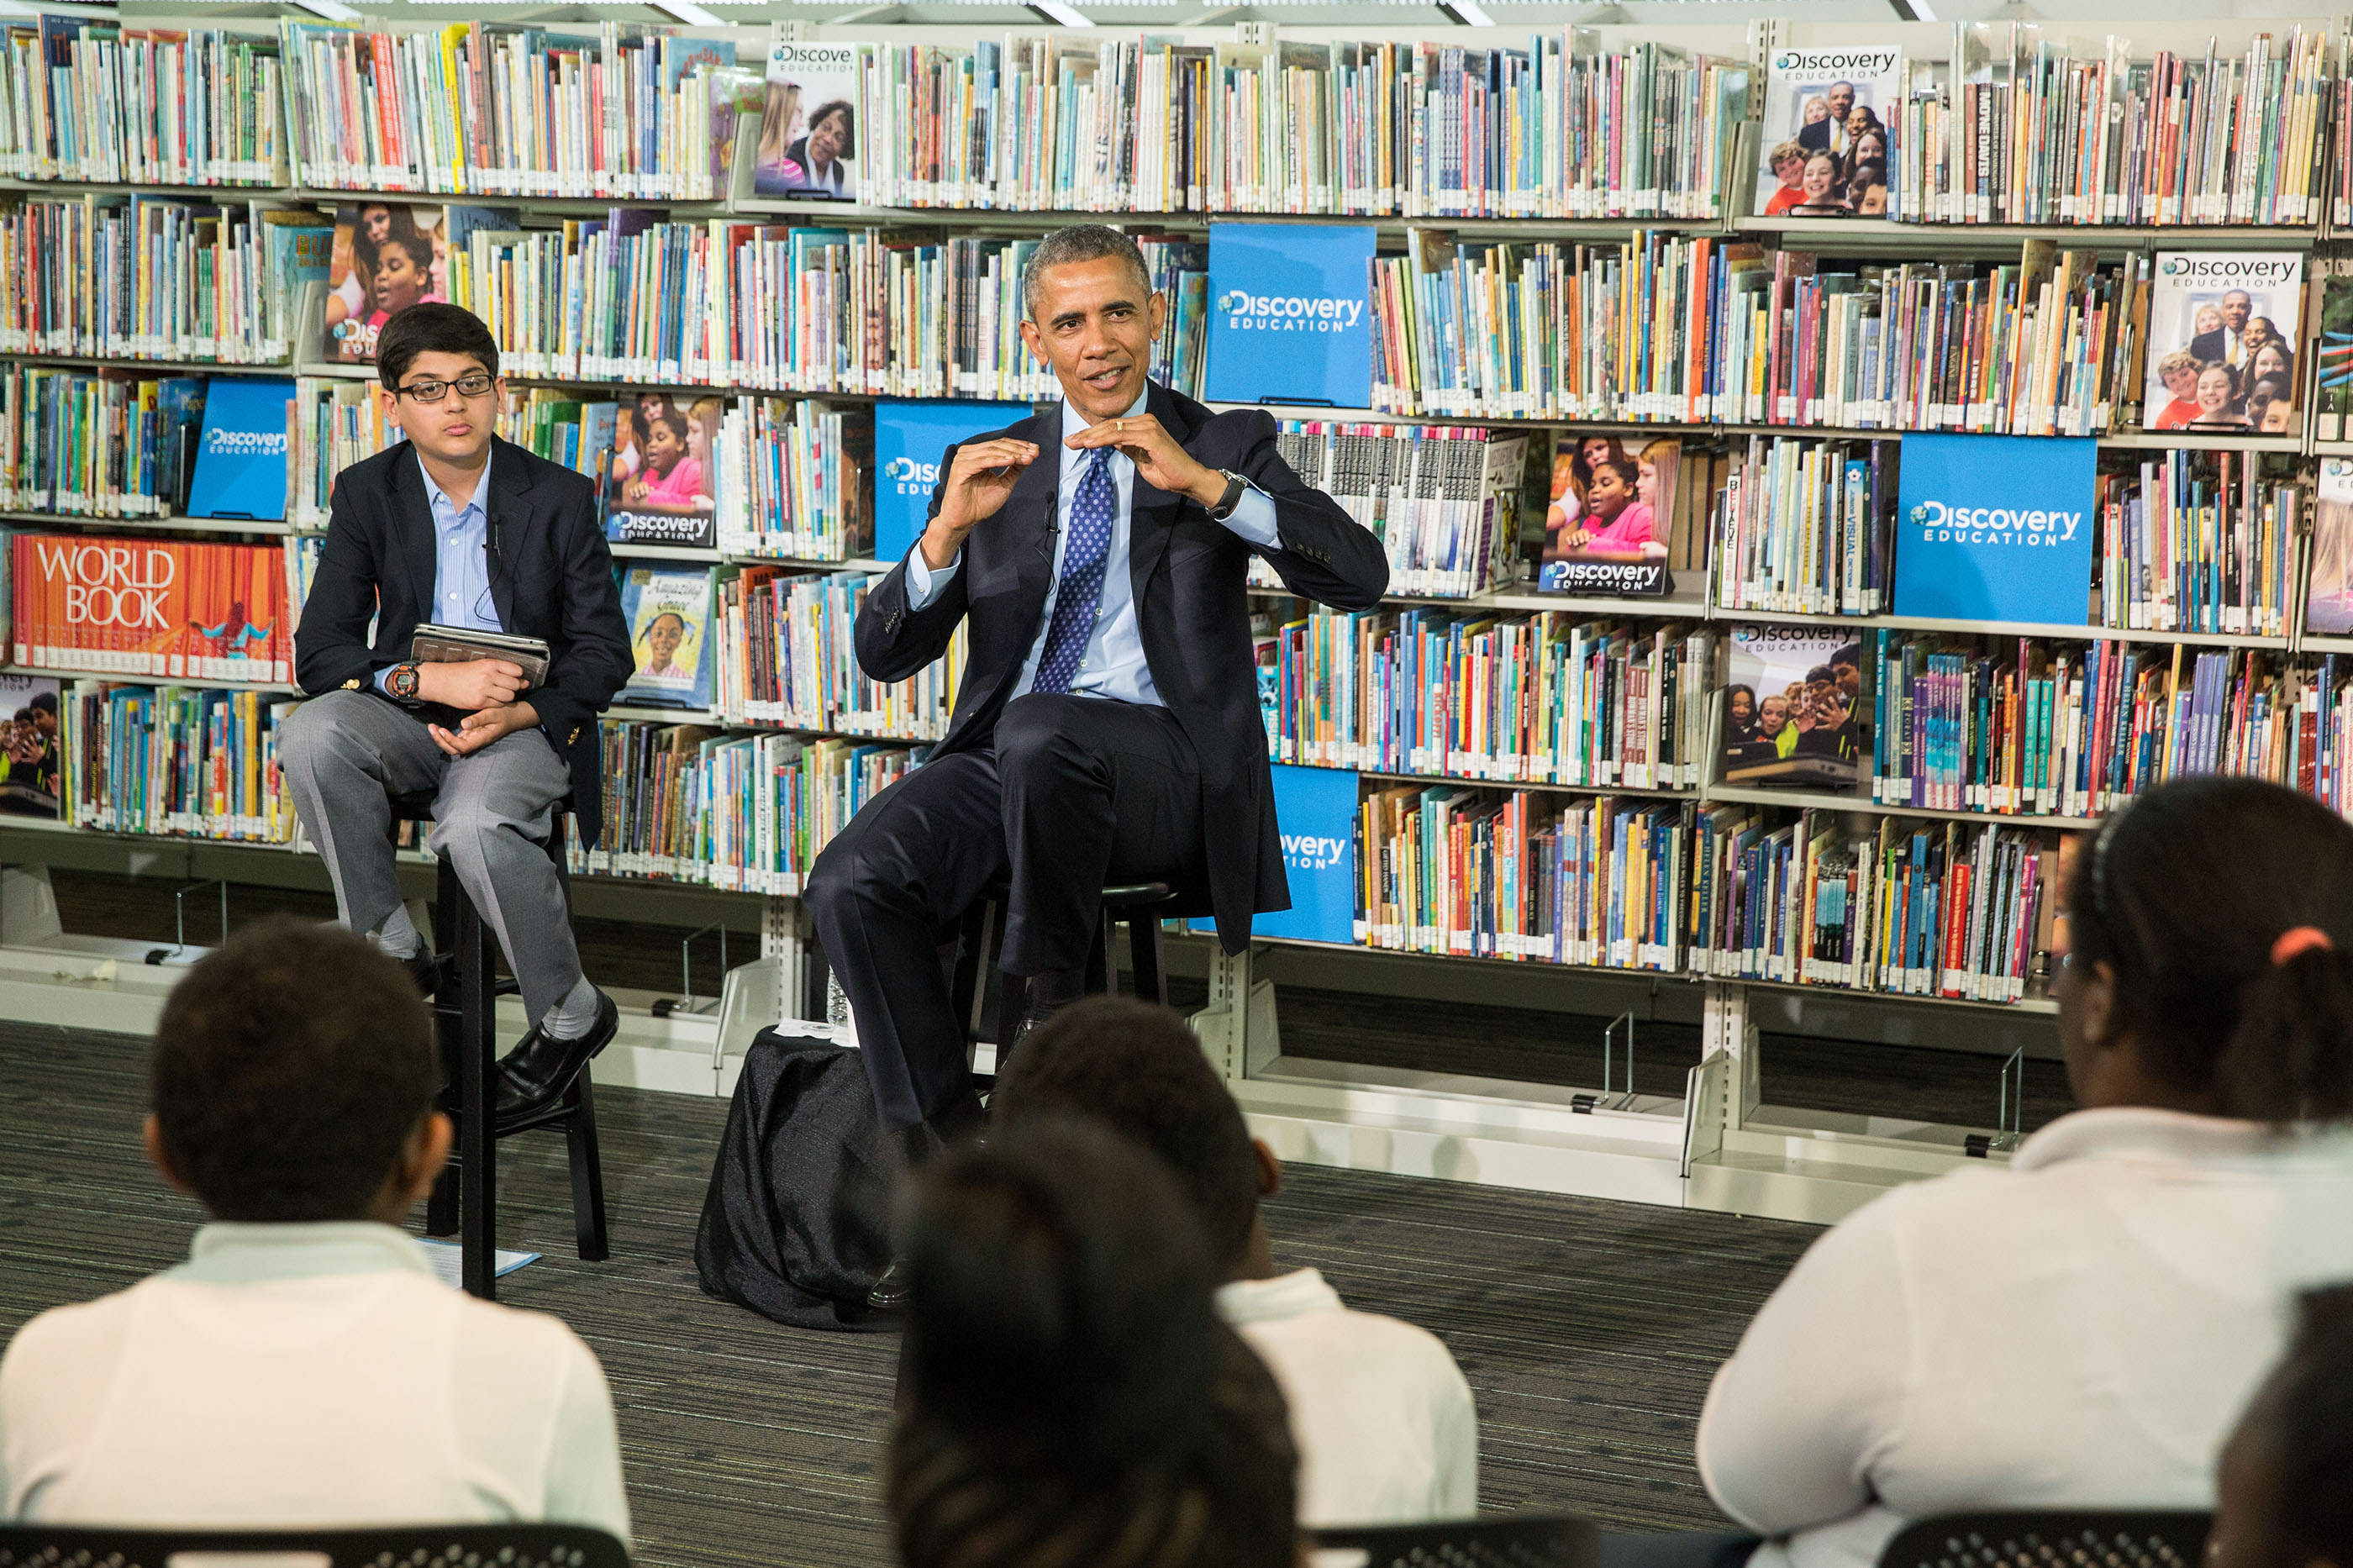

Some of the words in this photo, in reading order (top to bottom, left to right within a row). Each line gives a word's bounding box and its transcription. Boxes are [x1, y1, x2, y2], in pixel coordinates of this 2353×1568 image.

[782, 45, 854, 63] Discove
[1787, 52, 1895, 73] Discovery
[1785, 71, 1878, 81] EDUCATION
[1977, 134, 1990, 176] DAVIS
[2173, 278, 2277, 287] EDUCATION
[2175, 257, 2296, 282] Discovery
[1229, 290, 1363, 327] Discovery
[1230, 317, 1343, 333] EDUCATION
[210, 445, 279, 456] EDUCATION
[212, 428, 287, 452] Discovery
[620, 511, 709, 538] Discovery
[1924, 500, 2081, 540] Discovery
[1846, 516, 1856, 557] VISUAL
[1924, 529, 2056, 547] EDUCATION
[36, 543, 175, 588] WORLD
[1555, 560, 1659, 586] Discovery
[66, 585, 170, 629] BOOK
[1745, 642, 1838, 653] EDUCATION
[1747, 624, 1854, 645] Discovery
[2121, 685, 2131, 718] HELEN
[2117, 720, 2128, 756] KELLER
[1503, 827, 1513, 856] Chuck
[1503, 857, 1513, 883] Close
[1703, 845, 1712, 876] HELEN
[1700, 879, 1709, 913] KELLER
